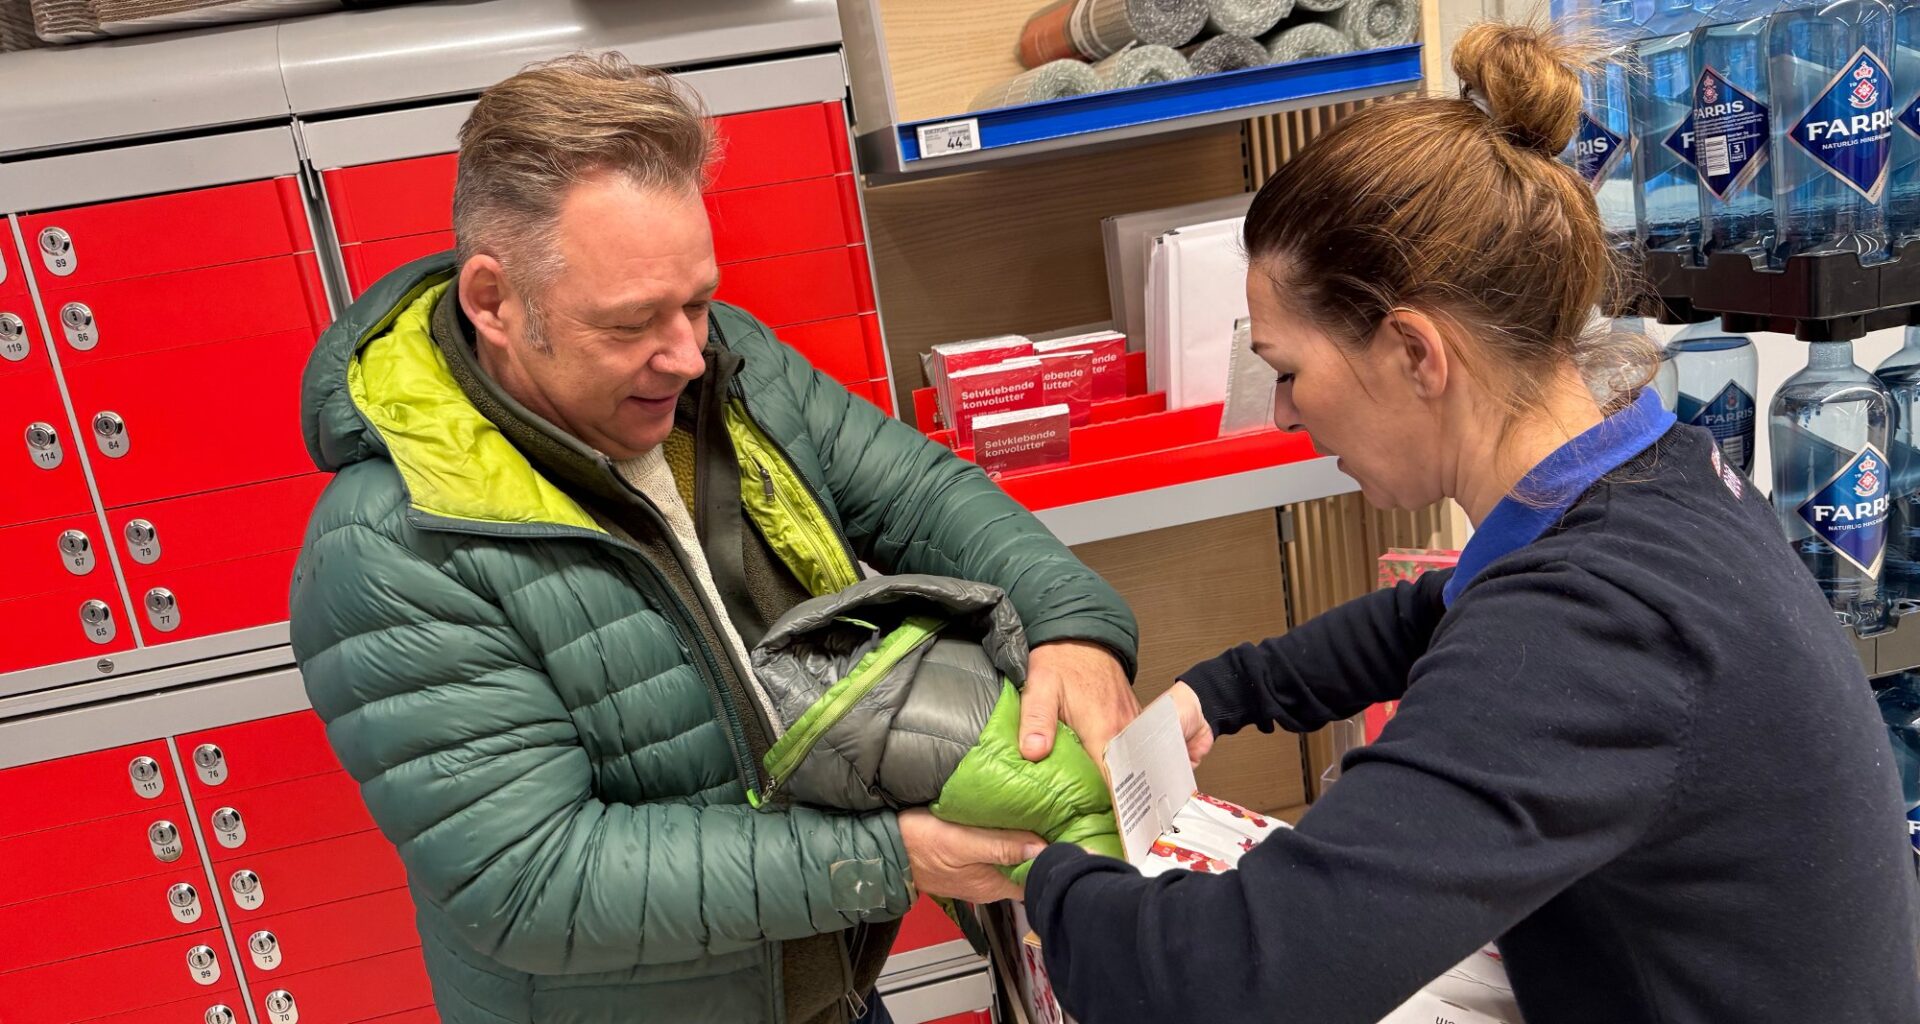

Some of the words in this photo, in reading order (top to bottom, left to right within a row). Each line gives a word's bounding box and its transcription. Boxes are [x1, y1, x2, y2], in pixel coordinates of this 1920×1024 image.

[947, 136, 963, 149] 44
[1578, 136, 1609, 156] RIS
[1821, 138, 1859, 151] NATURLIG
[1733, 144, 1741, 154] 3
[55, 258, 67, 268] 89
[77, 332, 89, 342] 86
[6, 343, 22, 353] 119
[1043, 368, 1084, 381] ebende
[1042, 379, 1073, 390] lutter
[961, 381, 1035, 400] Selvklebende
[962, 392, 1025, 410] konvolutter
[1704, 406, 1753, 425] FARRIS
[985, 430, 1056, 449] Selvklebende
[108, 440, 120, 450] 84
[985, 440, 1046, 458] konvolutter
[40, 451, 56, 462] 114
[1813, 494, 1890, 522] FARR
[140, 547, 151, 557] 79
[74, 557, 85, 567] 67
[160, 615, 170, 624] 77
[96, 627, 107, 637] 65
[208, 770, 219, 779] 76
[143, 782, 157, 791] 111
[227, 832, 238, 841] 75
[161, 845, 177, 855] 104
[244, 894, 256, 904] 74
[180, 907, 195, 917] 101
[262, 955, 273, 964] 73
[200, 969, 212, 979] 99
[279, 1012, 290, 1022] 70
